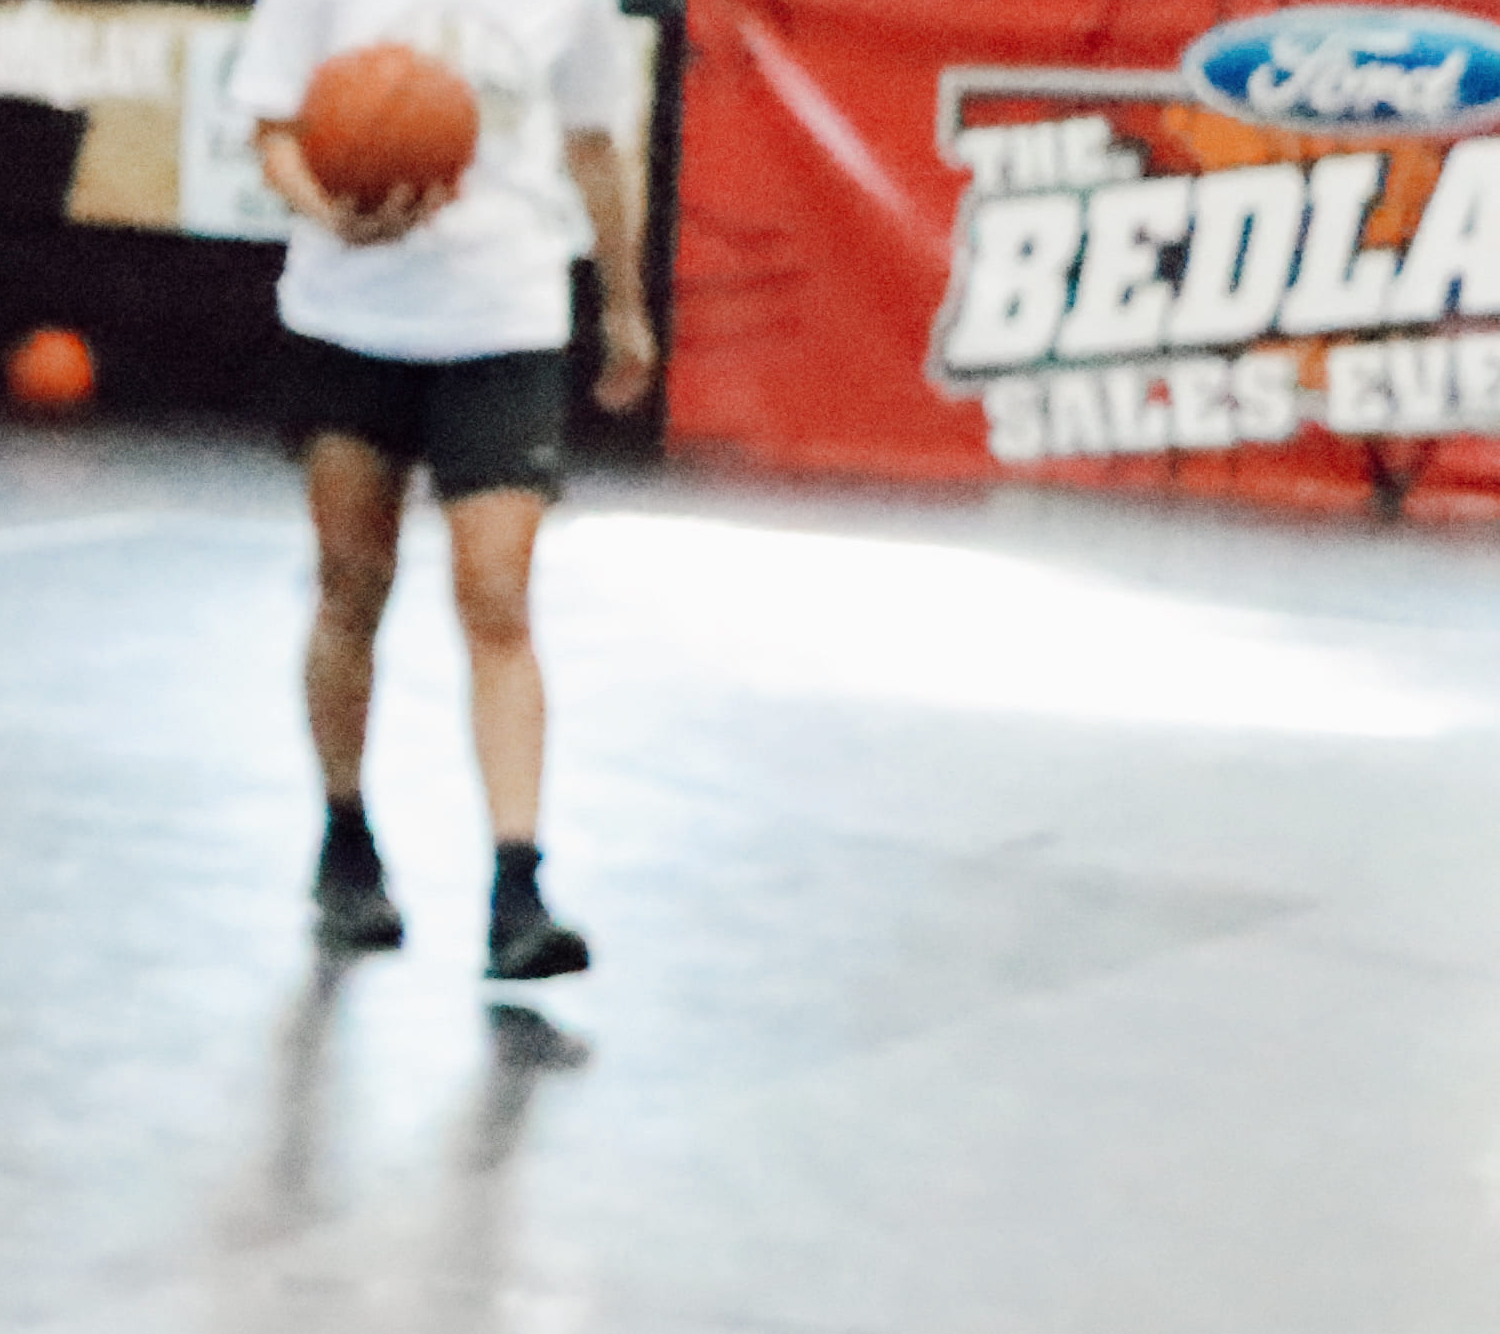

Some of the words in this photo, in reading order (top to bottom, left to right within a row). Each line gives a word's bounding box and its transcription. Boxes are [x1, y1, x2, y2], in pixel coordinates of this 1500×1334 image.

[1248, 29, 1470, 117] Ford
[955, 115, 1114, 189] THE
[987, 351, 1297, 459] SALES
